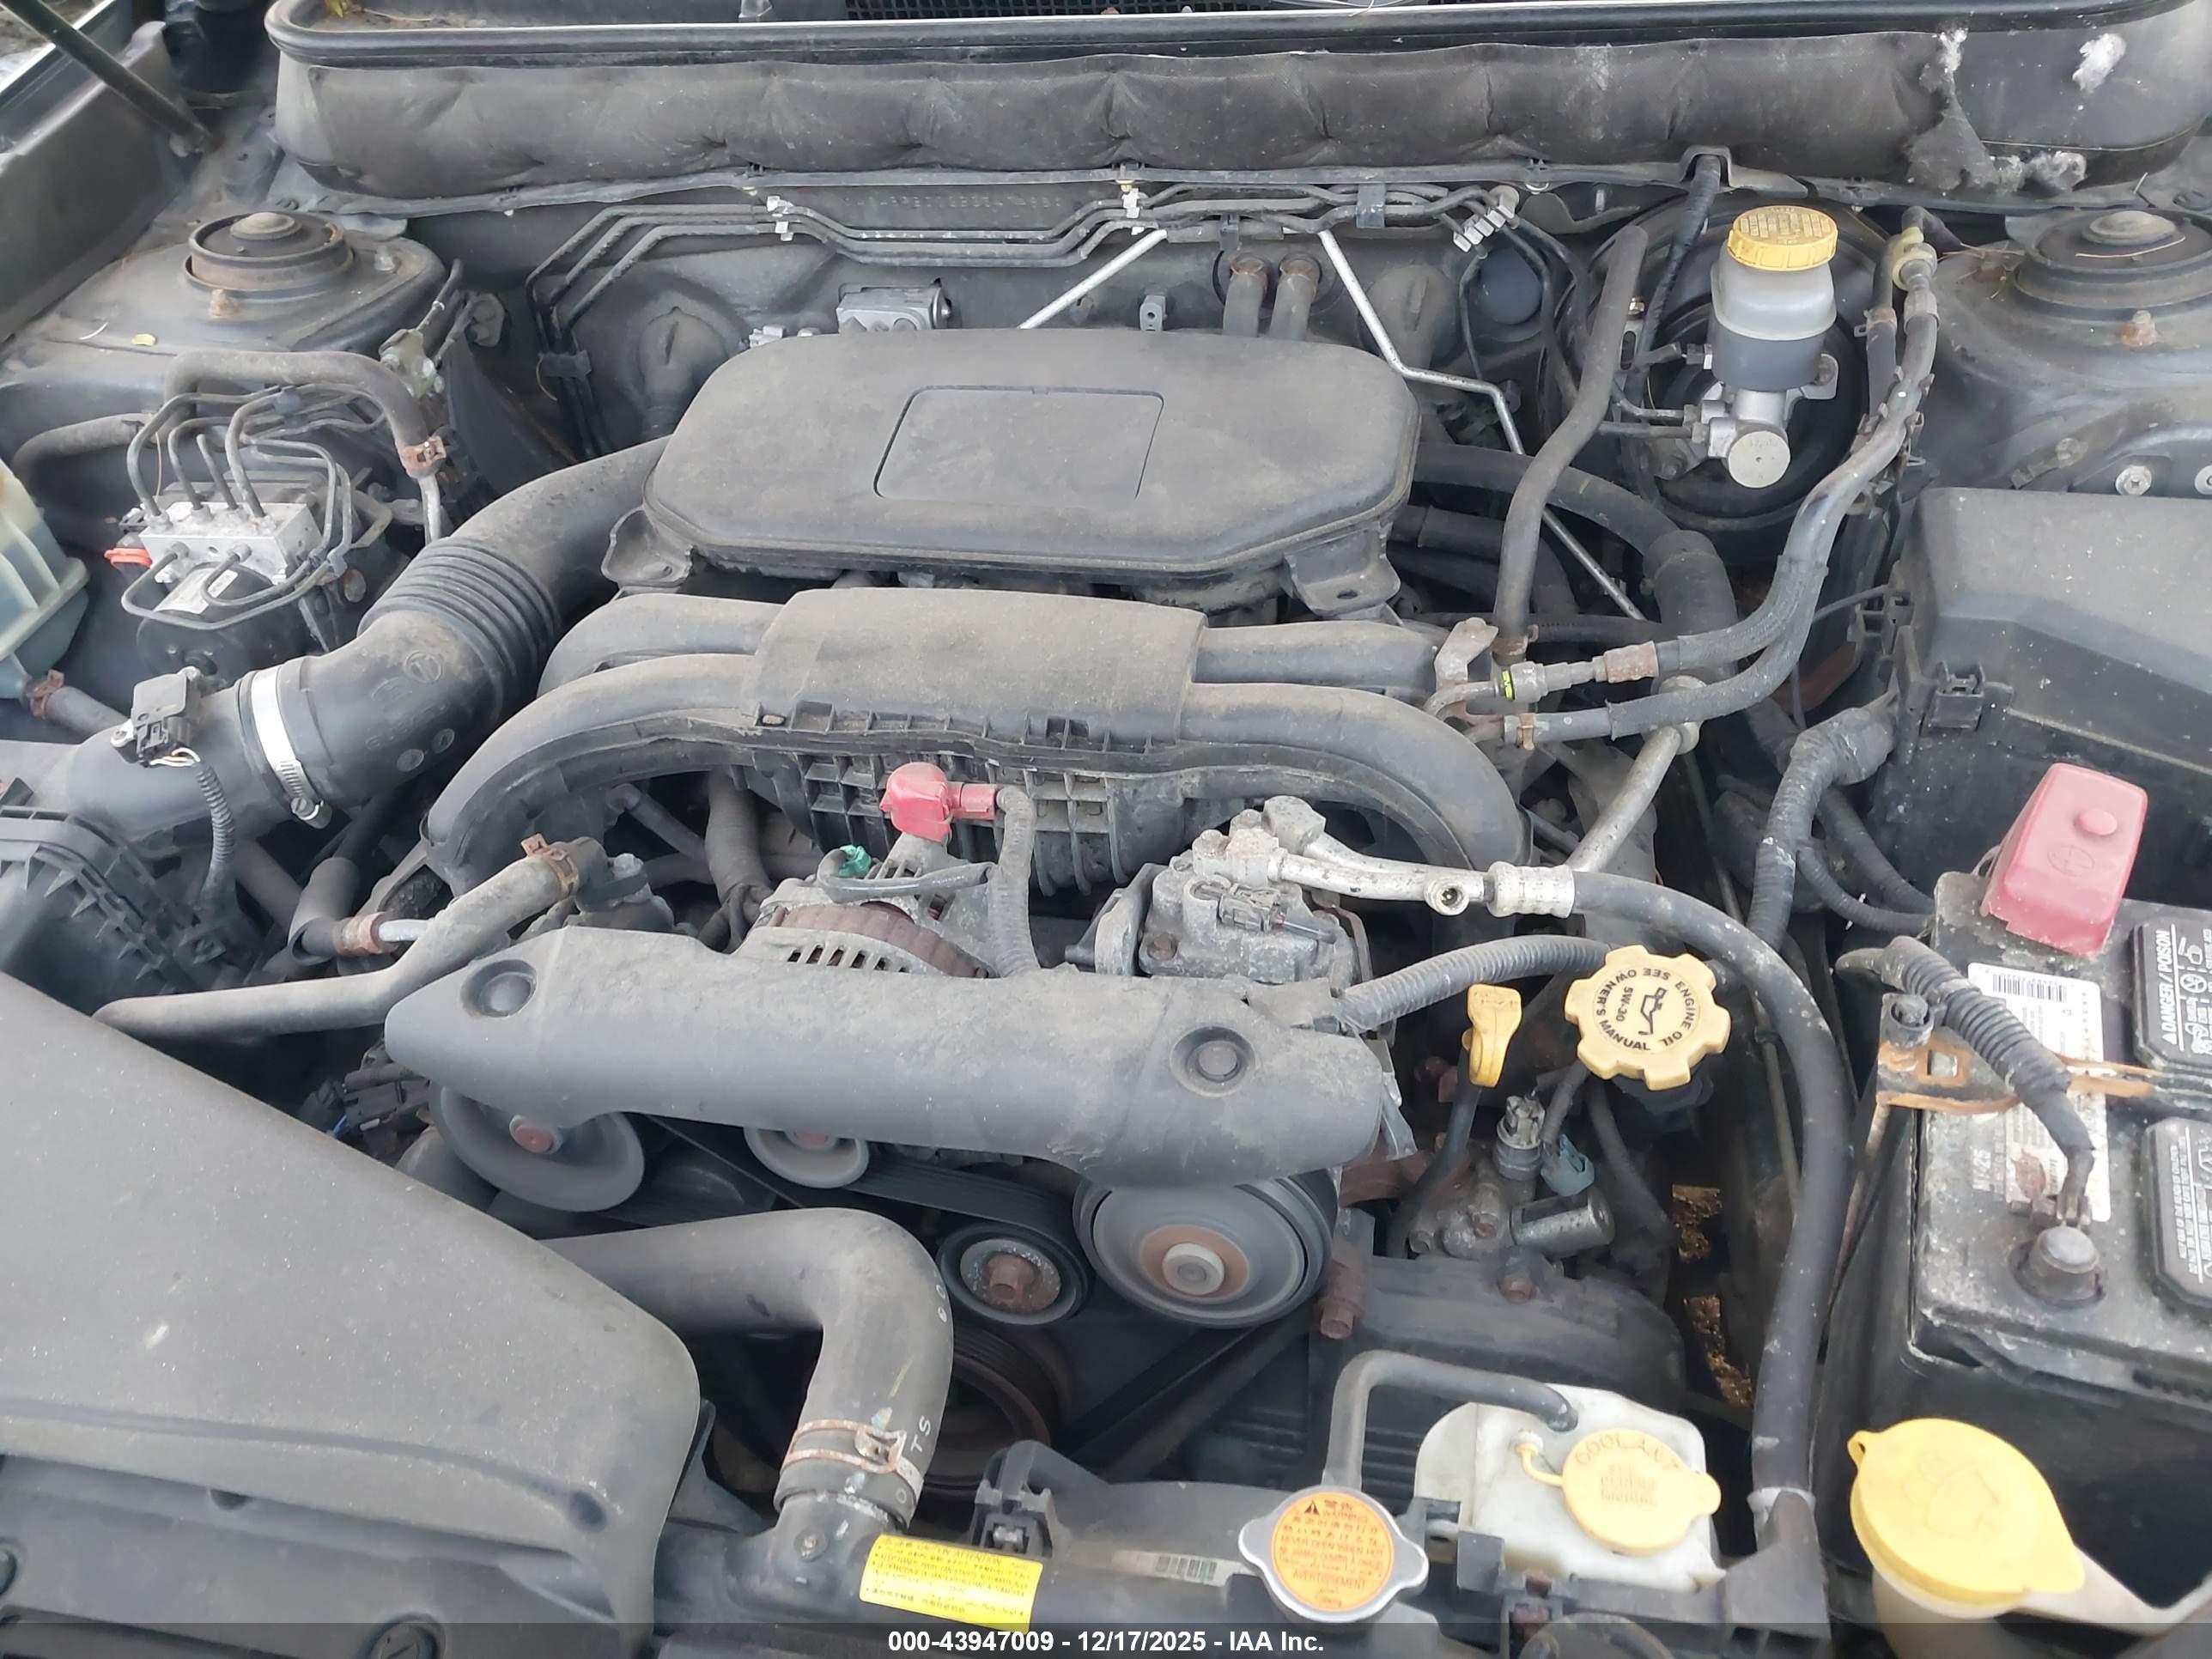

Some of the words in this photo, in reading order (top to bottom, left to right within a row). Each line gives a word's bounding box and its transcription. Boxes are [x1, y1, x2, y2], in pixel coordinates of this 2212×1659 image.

[2155, 929, 2173, 973] POISON
[1596, 969, 1638, 1017] OWNER'S
[1643, 968, 1671, 981] SEE
[1616, 986, 1633, 1022] 5W-30
[1674, 981, 1696, 1030] ENGINE
[2159, 982, 2177, 1032] DANGER
[1600, 1020, 1651, 1051] MANUAL
[1659, 1030, 1683, 1048] OIL
